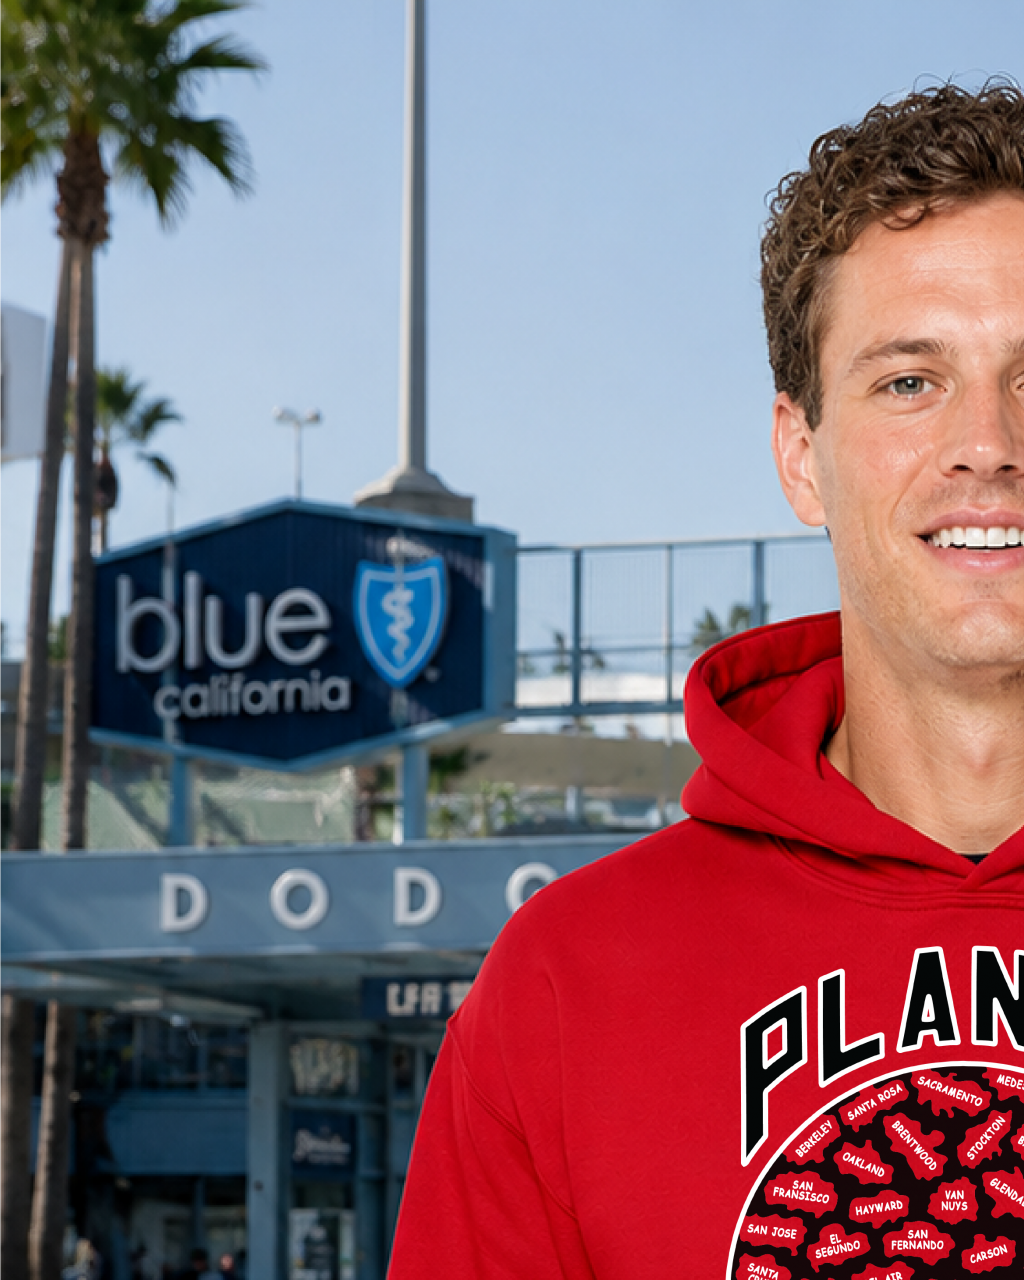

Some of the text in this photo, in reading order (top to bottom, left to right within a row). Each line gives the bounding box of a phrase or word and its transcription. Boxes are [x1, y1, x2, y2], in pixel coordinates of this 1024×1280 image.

[116, 571, 332, 673] blue
[154, 669, 351, 720] california
[917, 1075, 983, 1107] SACRAMENTO
[847, 1083, 903, 1121] SANTA ROSA
[794, 1119, 833, 1158] BERKELEY
[891, 1120, 937, 1171] BRENTWOOD
[966, 1115, 1006, 1161] STOCKTON
[842, 1151, 885, 1178] OAKLAND
[792, 1179, 814, 1192] SAN
[944, 1189, 965, 1200] VAN
[772, 1186, 830, 1204] FRANSISCO
[855, 1199, 904, 1216] HAYWARD
[941, 1200, 968, 1211] NUYS
[746, 1223, 798, 1240] SAN JOSE
[829, 1233, 842, 1245] EL
[907, 1229, 929, 1240] SAN
[815, 1240, 861, 1259] SEGUNDO
[891, 1239, 945, 1251] FERNANDO
[969, 1243, 1008, 1264] CARSON
[747, 1262, 779, 1280] SANTA
